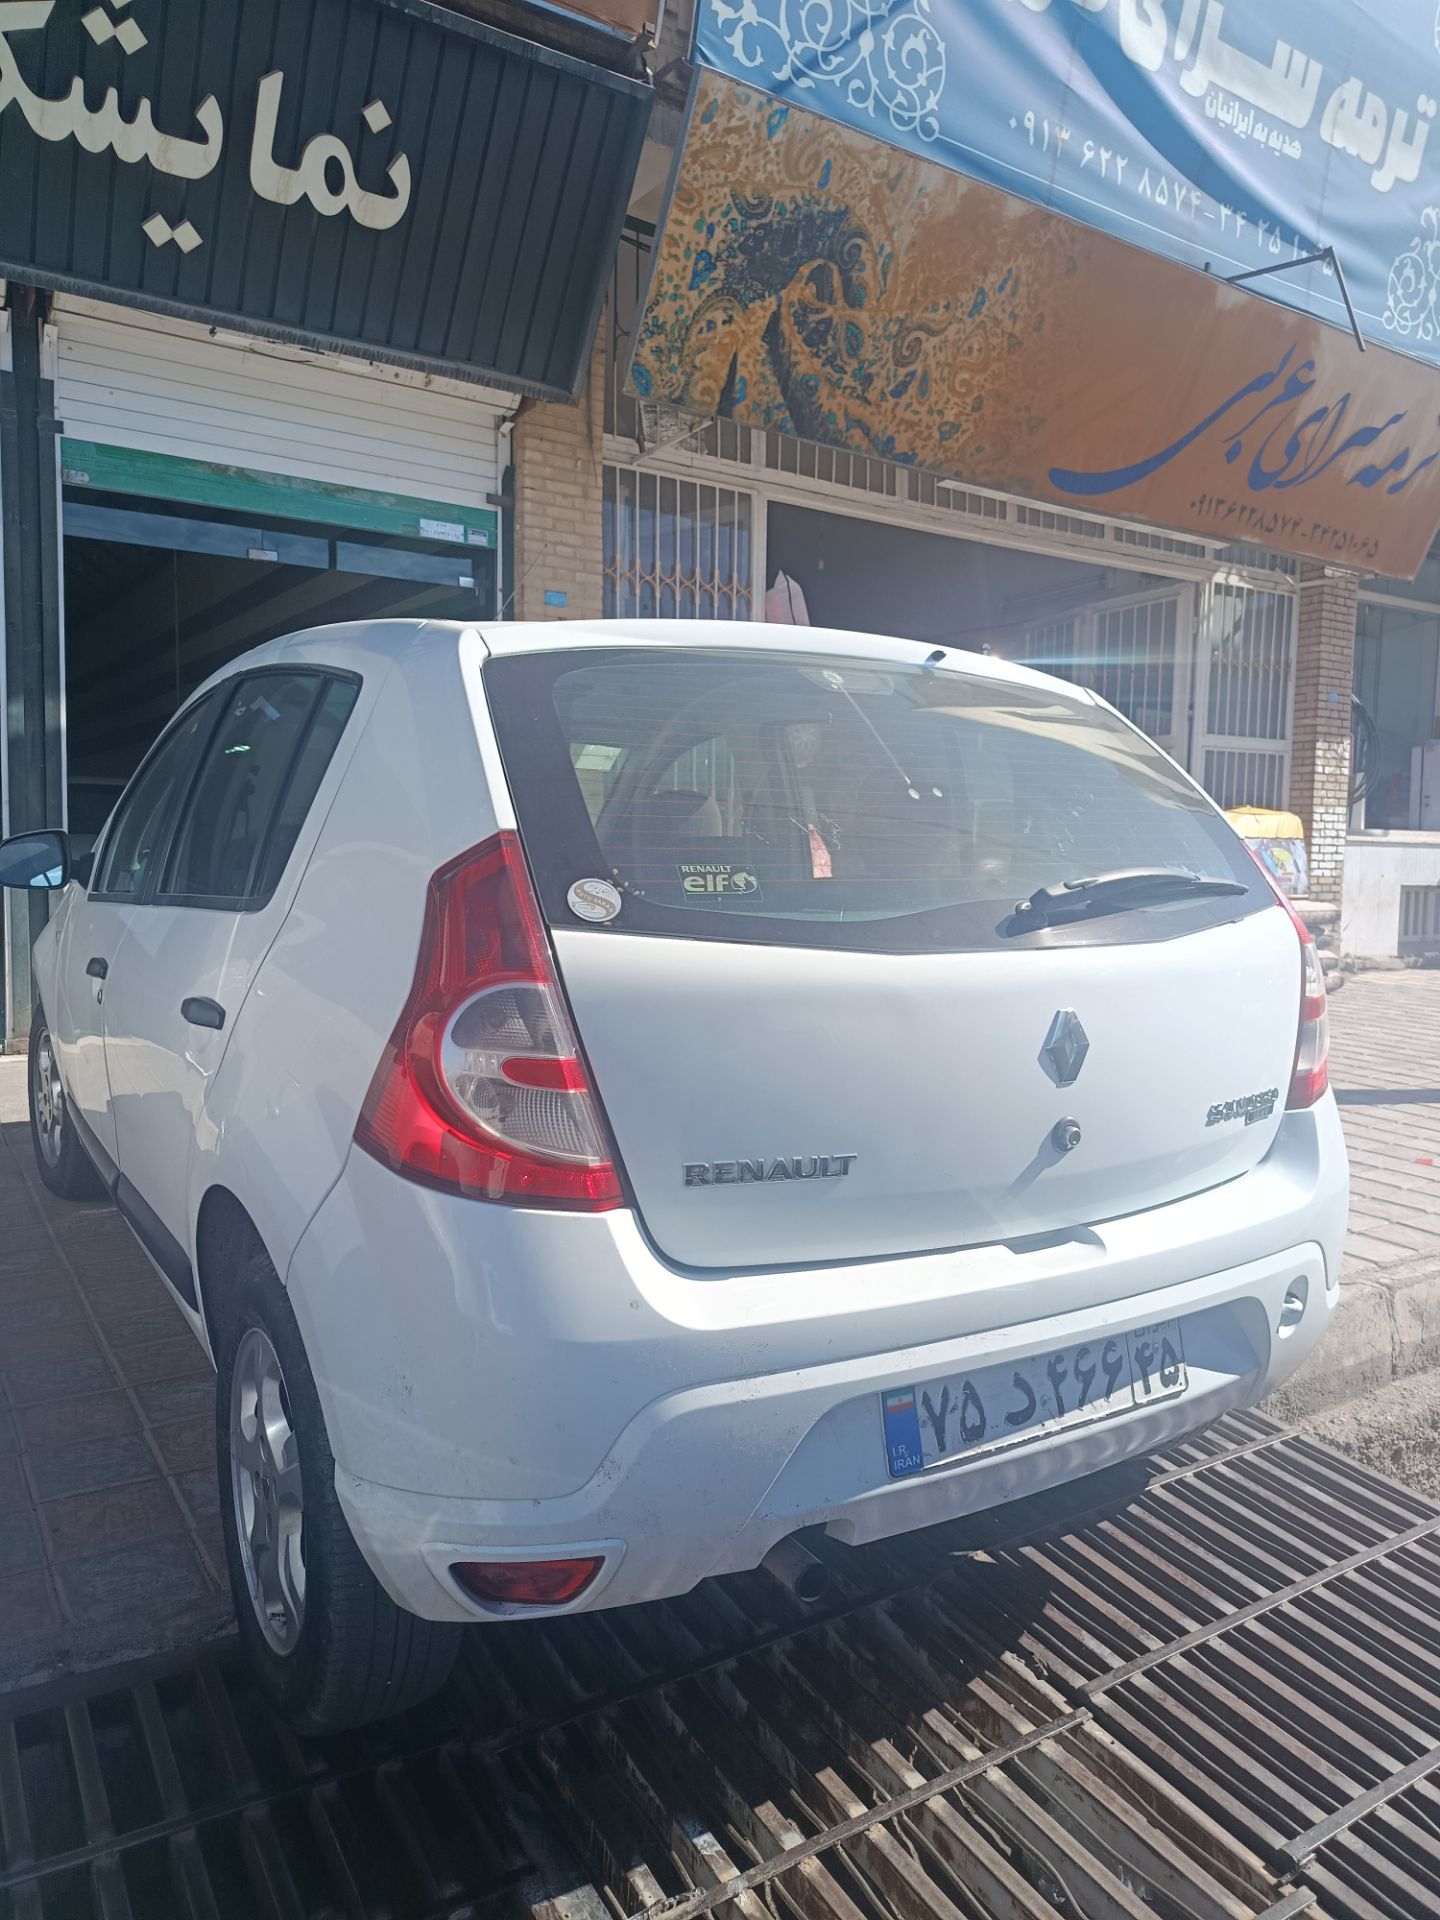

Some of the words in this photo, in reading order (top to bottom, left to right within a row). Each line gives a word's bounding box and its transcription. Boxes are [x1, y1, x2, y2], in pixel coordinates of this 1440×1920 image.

[1204, 90, 1255, 139] ایرانیان
[1009, 110, 1071, 158] ۰۹۱۳
[1080, 140, 1128, 185] ۶۲۲
[1253, 119, 1269, 149] به
[1267, 131, 1302, 160] هدیه
[1319, 75, 1438, 193] ترمه
[1247, 392, 1408, 491] سرای
[681, 865, 732, 873] RENAULT
[683, 874, 729, 892] elf
[683, 1153, 858, 1188] RENAULT
[921, 1379, 987, 1453] ۷۵
[894, 1454, 921, 1471] IRAN
